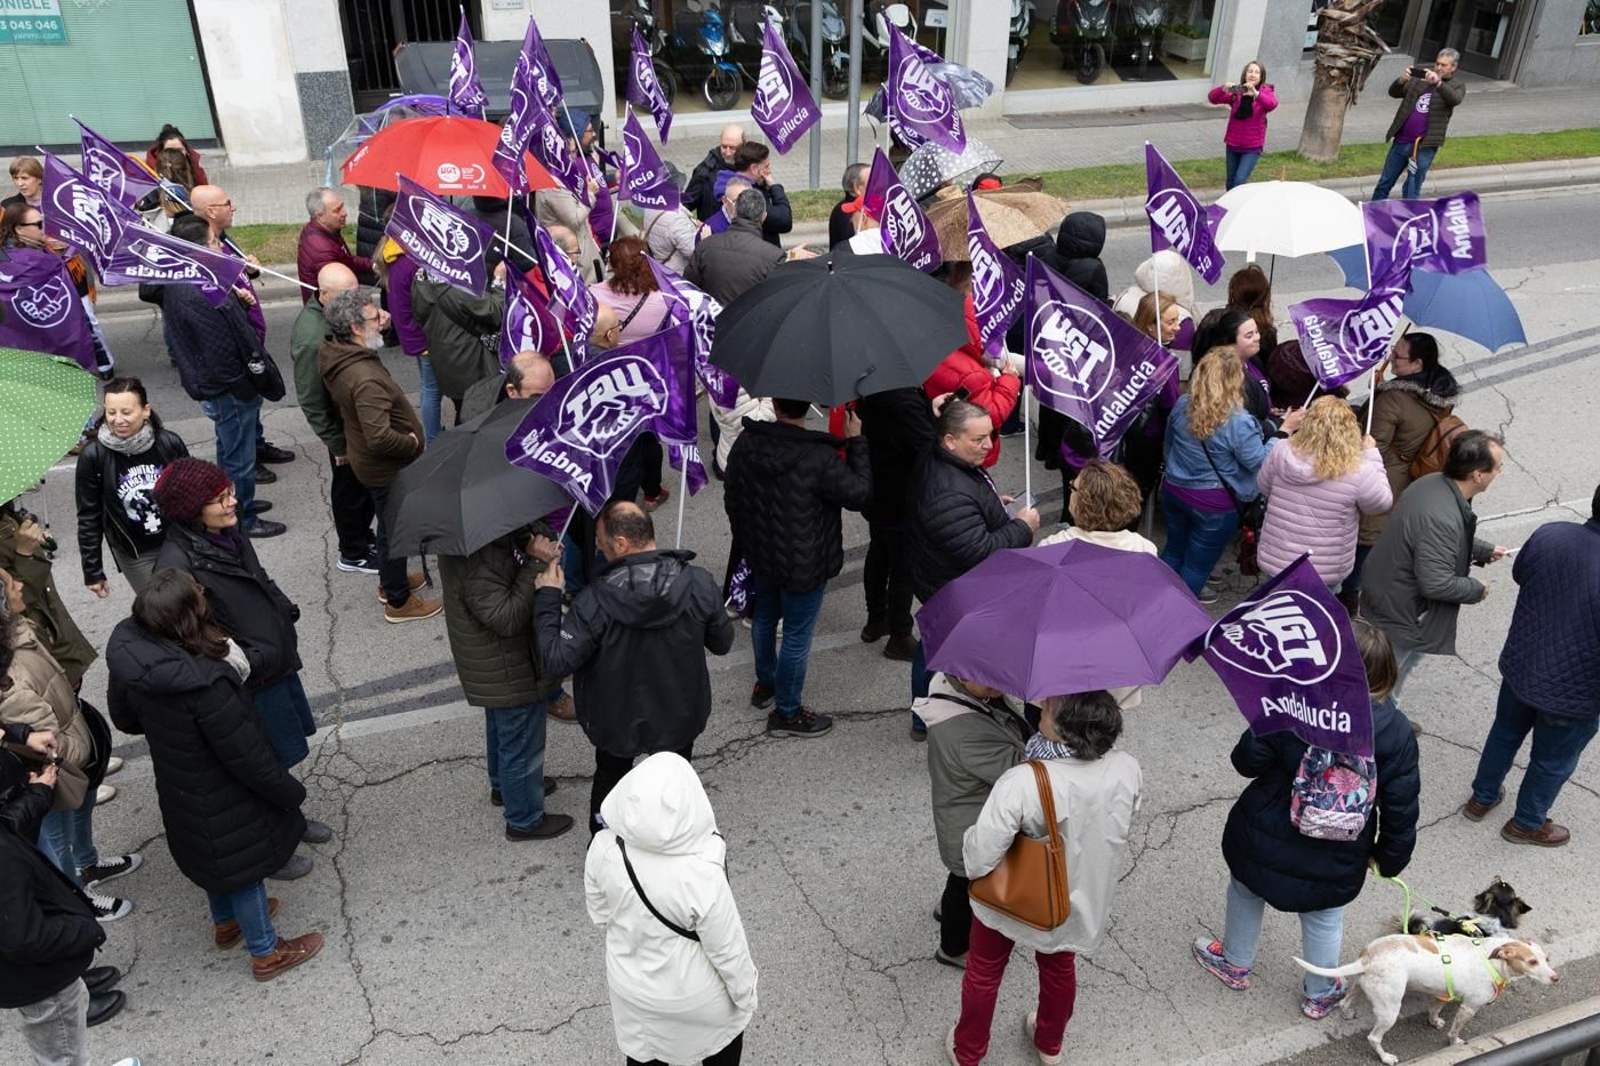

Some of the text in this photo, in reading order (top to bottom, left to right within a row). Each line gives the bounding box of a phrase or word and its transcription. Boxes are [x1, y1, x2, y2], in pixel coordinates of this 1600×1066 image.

[10, 20, 32, 30] 045
[35, 20, 58, 30] 046
[893, 190, 922, 248] UGT
[1150, 195, 1191, 252] UGT
[1041, 308, 1109, 388] UGT
[1241, 595, 1328, 666] UGT
[1260, 692, 1351, 733] Andalucía
